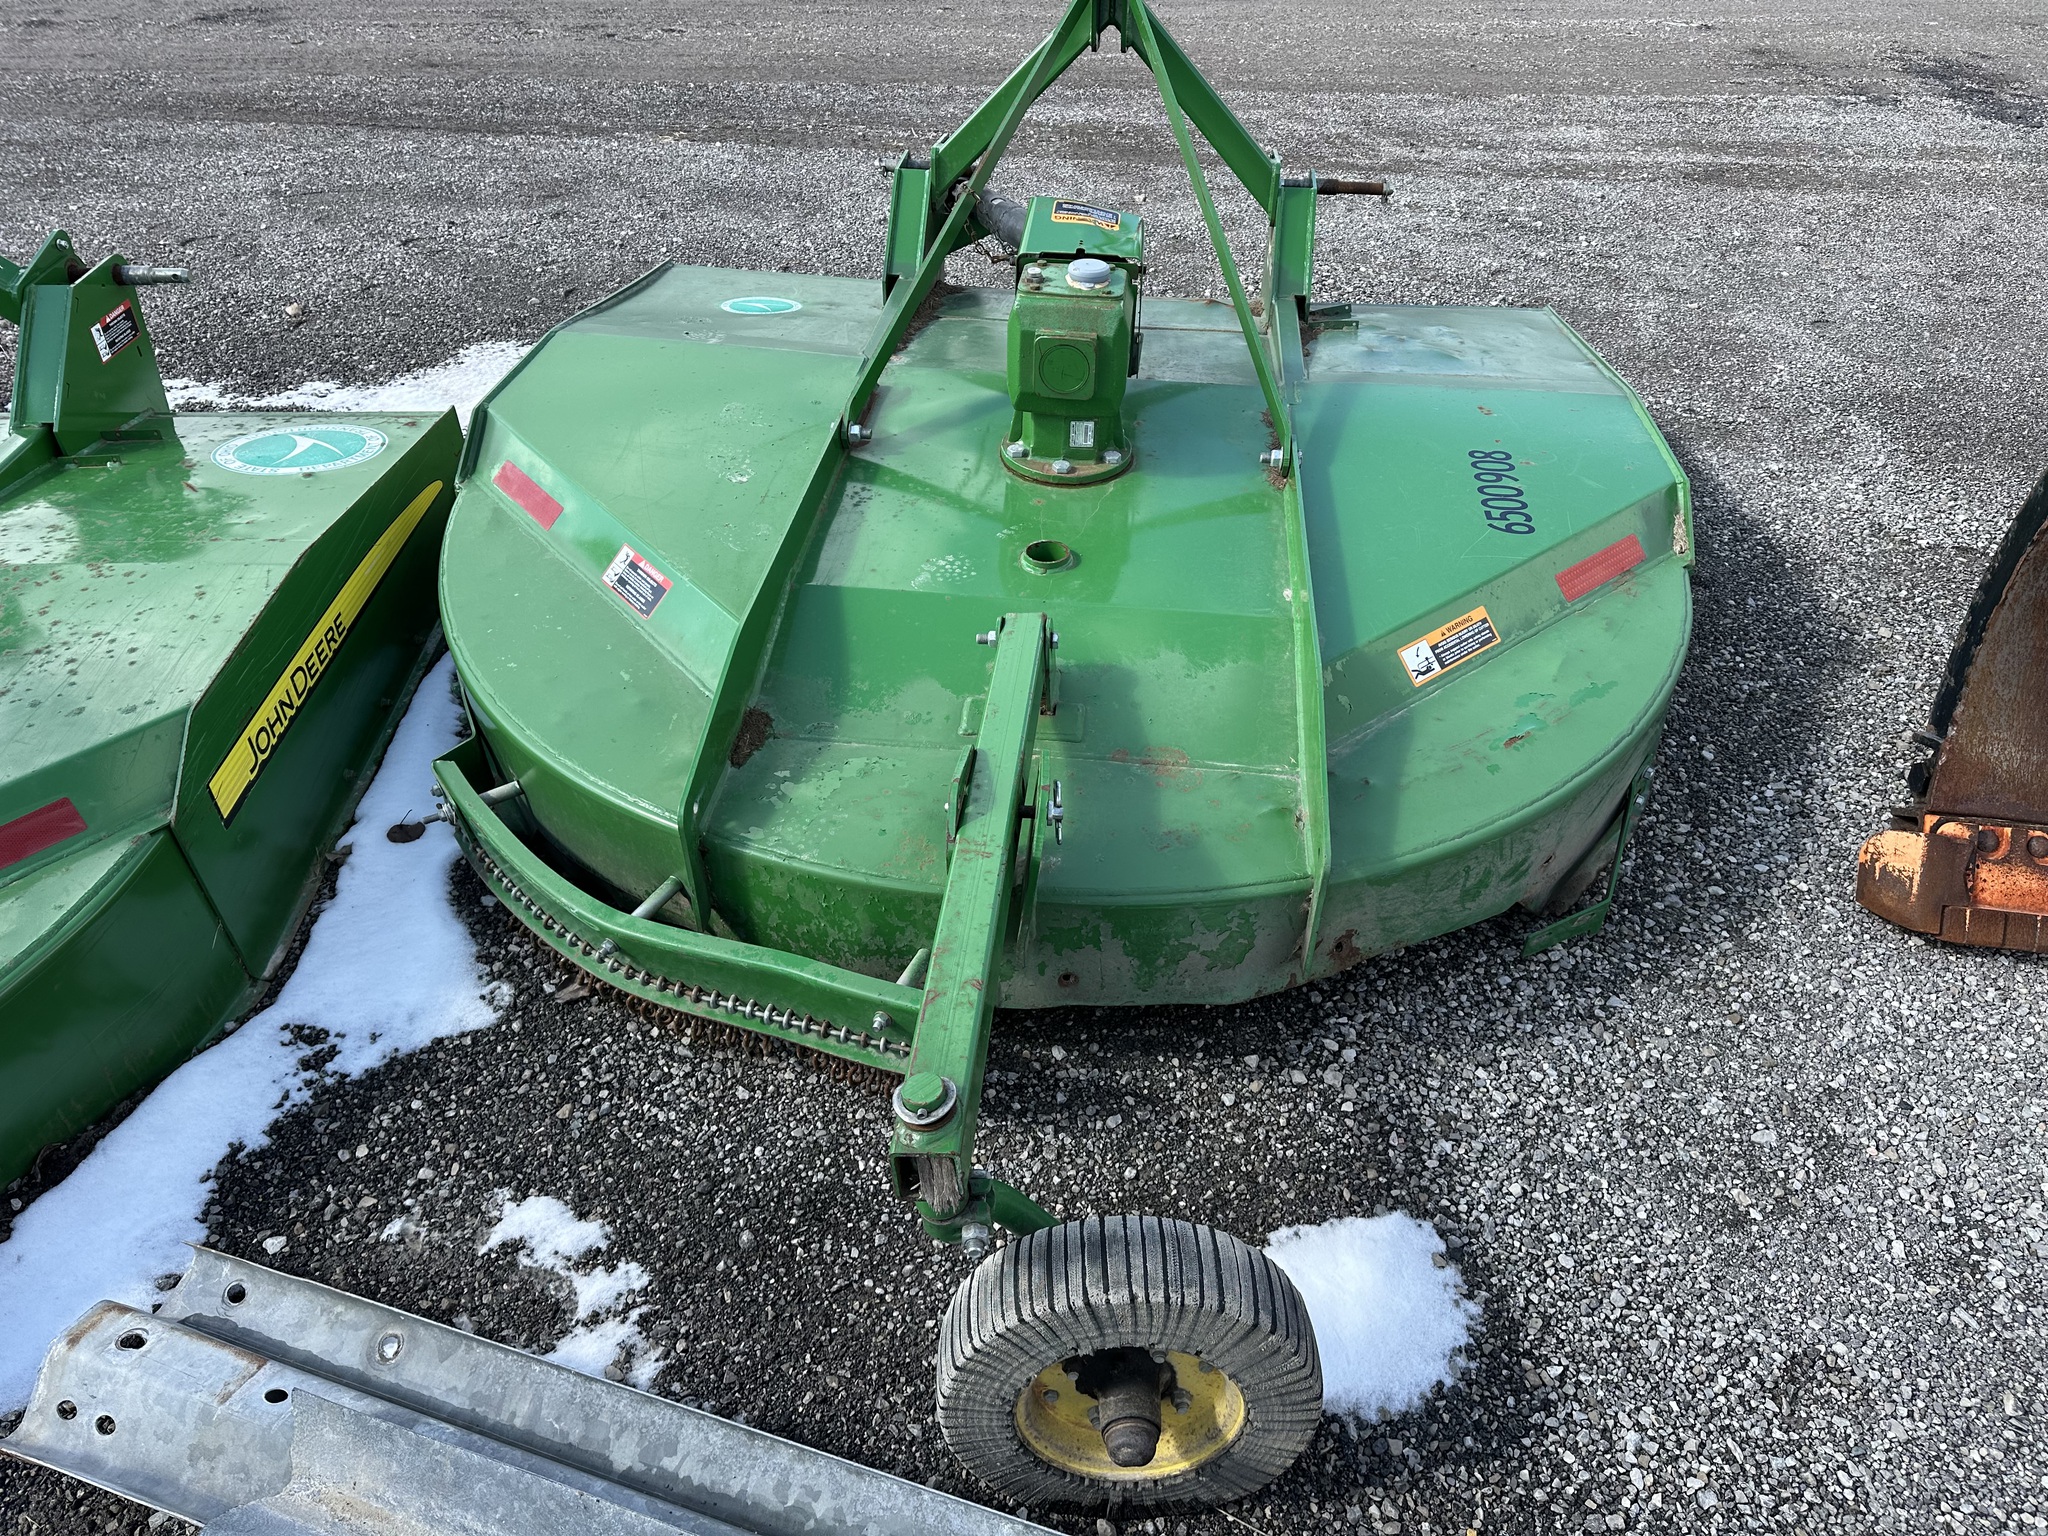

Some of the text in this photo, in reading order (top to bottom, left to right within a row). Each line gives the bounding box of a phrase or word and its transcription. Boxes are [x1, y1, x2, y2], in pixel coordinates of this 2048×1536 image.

[109, 304, 125, 320] DANGER
[1468, 449, 1536, 535] 6500908
[644, 563, 666, 583] DANGER
[1445, 615, 1474, 634] WARNING
[247, 612, 347, 774] JOHN DEERE
